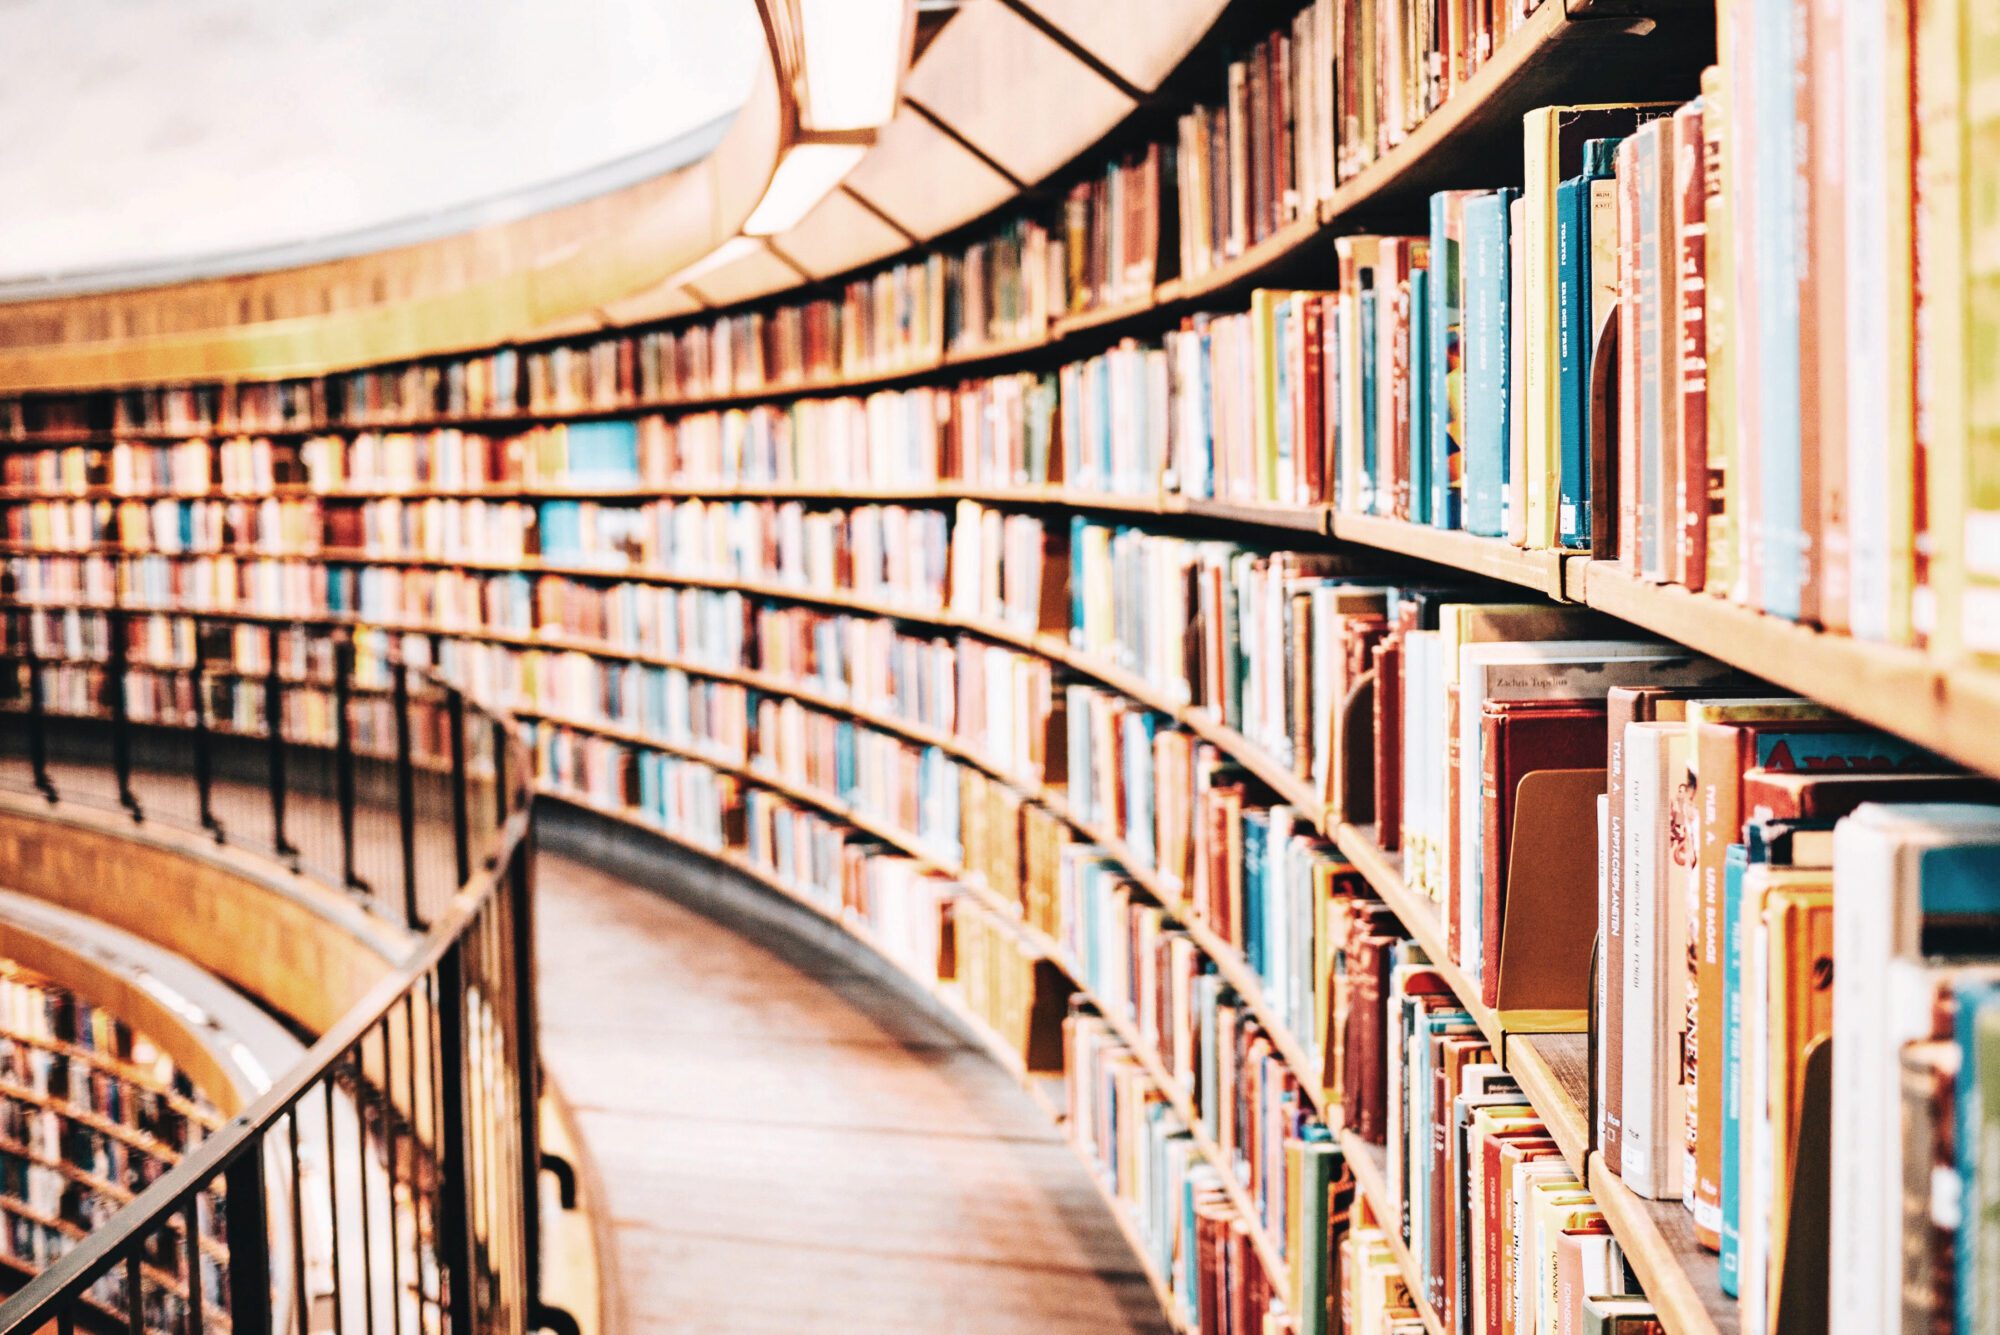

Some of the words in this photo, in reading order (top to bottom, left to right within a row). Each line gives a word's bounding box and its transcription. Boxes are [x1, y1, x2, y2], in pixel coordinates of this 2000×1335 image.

[1561, 331, 1569, 358] FRED
[1497, 677, 1528, 688] Zachris
[1530, 676, 1568, 689] Topelius
[1612, 741, 1621, 778] TYLER,
[1612, 783, 1620, 795] A.
[1705, 784, 1716, 825] TYLER,
[1706, 830, 1715, 846] A.
[1706, 867, 1716, 902] UTAN
[1705, 906, 1716, 964] BAGAGE
[1686, 980, 1699, 1057] ANNE
